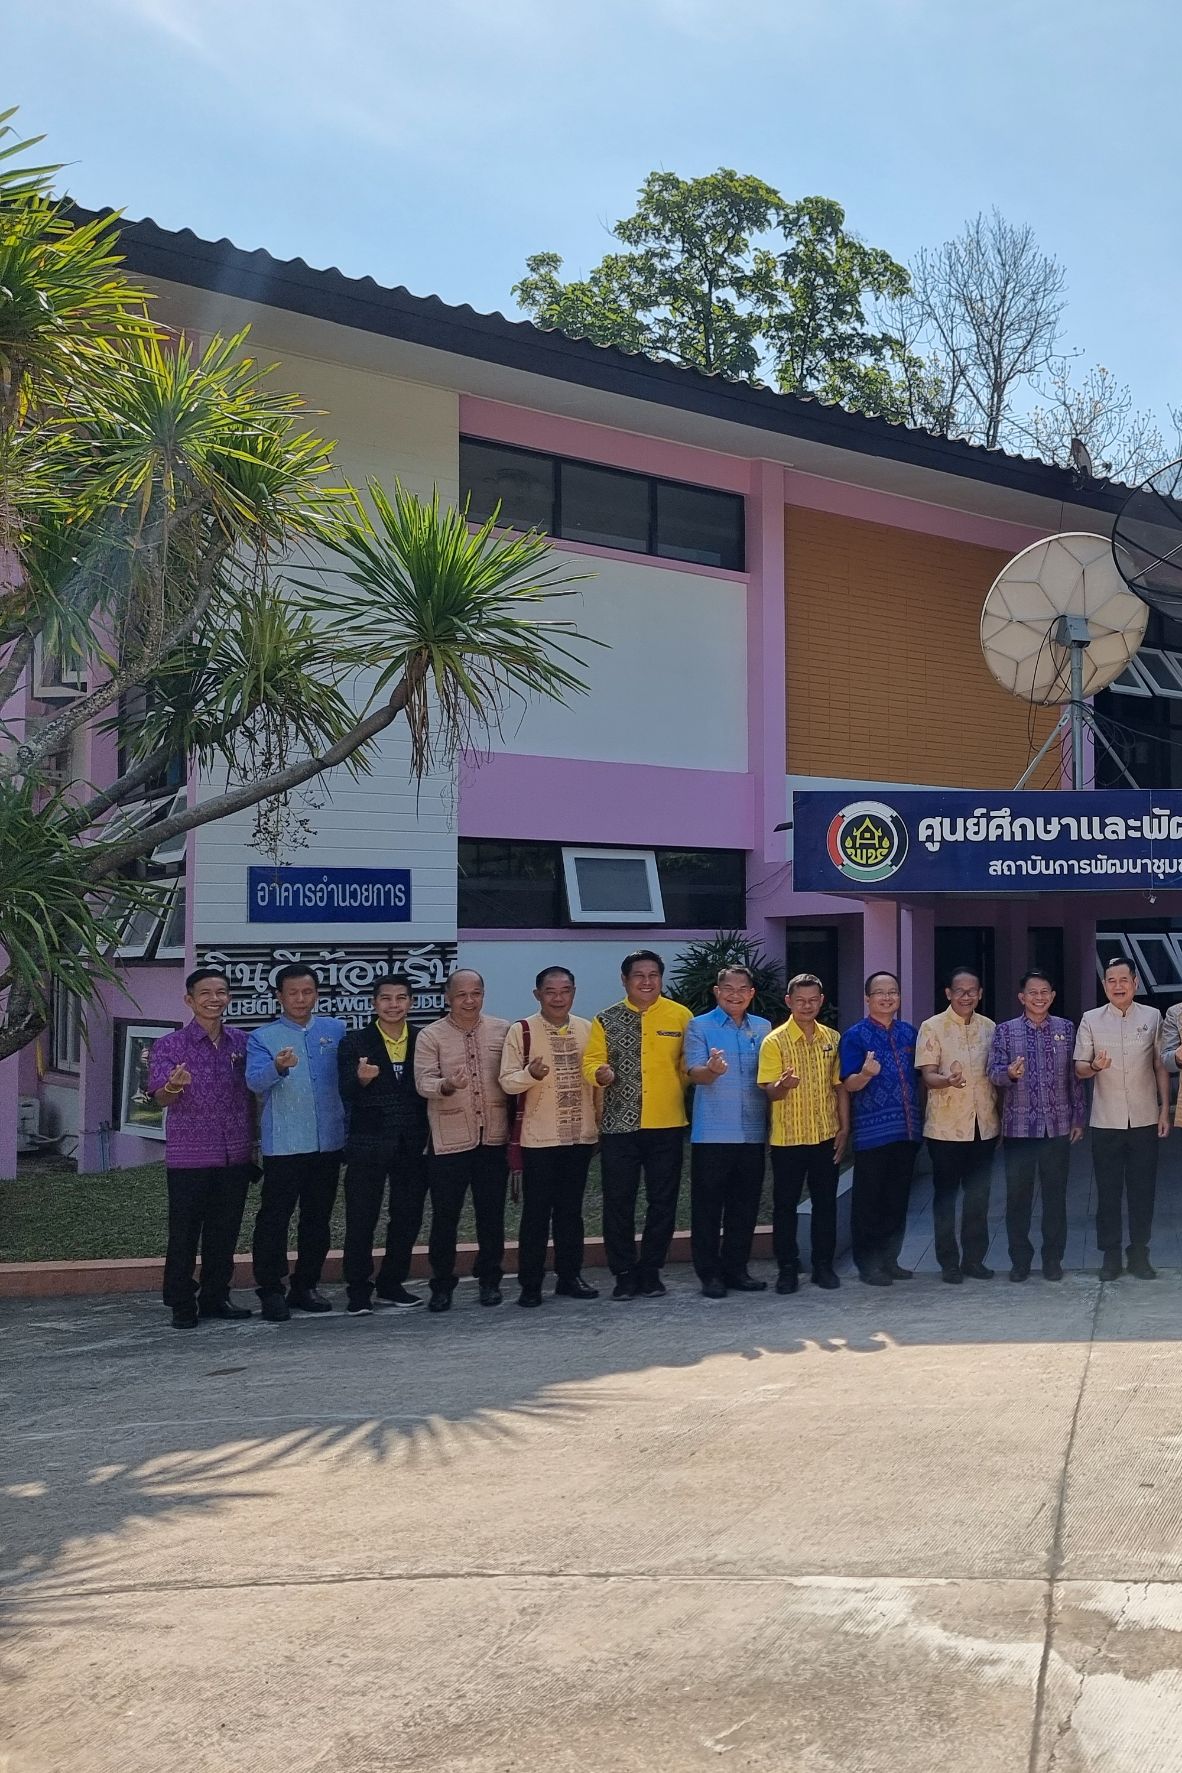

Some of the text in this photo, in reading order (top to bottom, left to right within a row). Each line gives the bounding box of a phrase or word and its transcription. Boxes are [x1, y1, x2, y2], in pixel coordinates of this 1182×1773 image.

[257, 876, 406, 907] อาคารอำนวยการ
